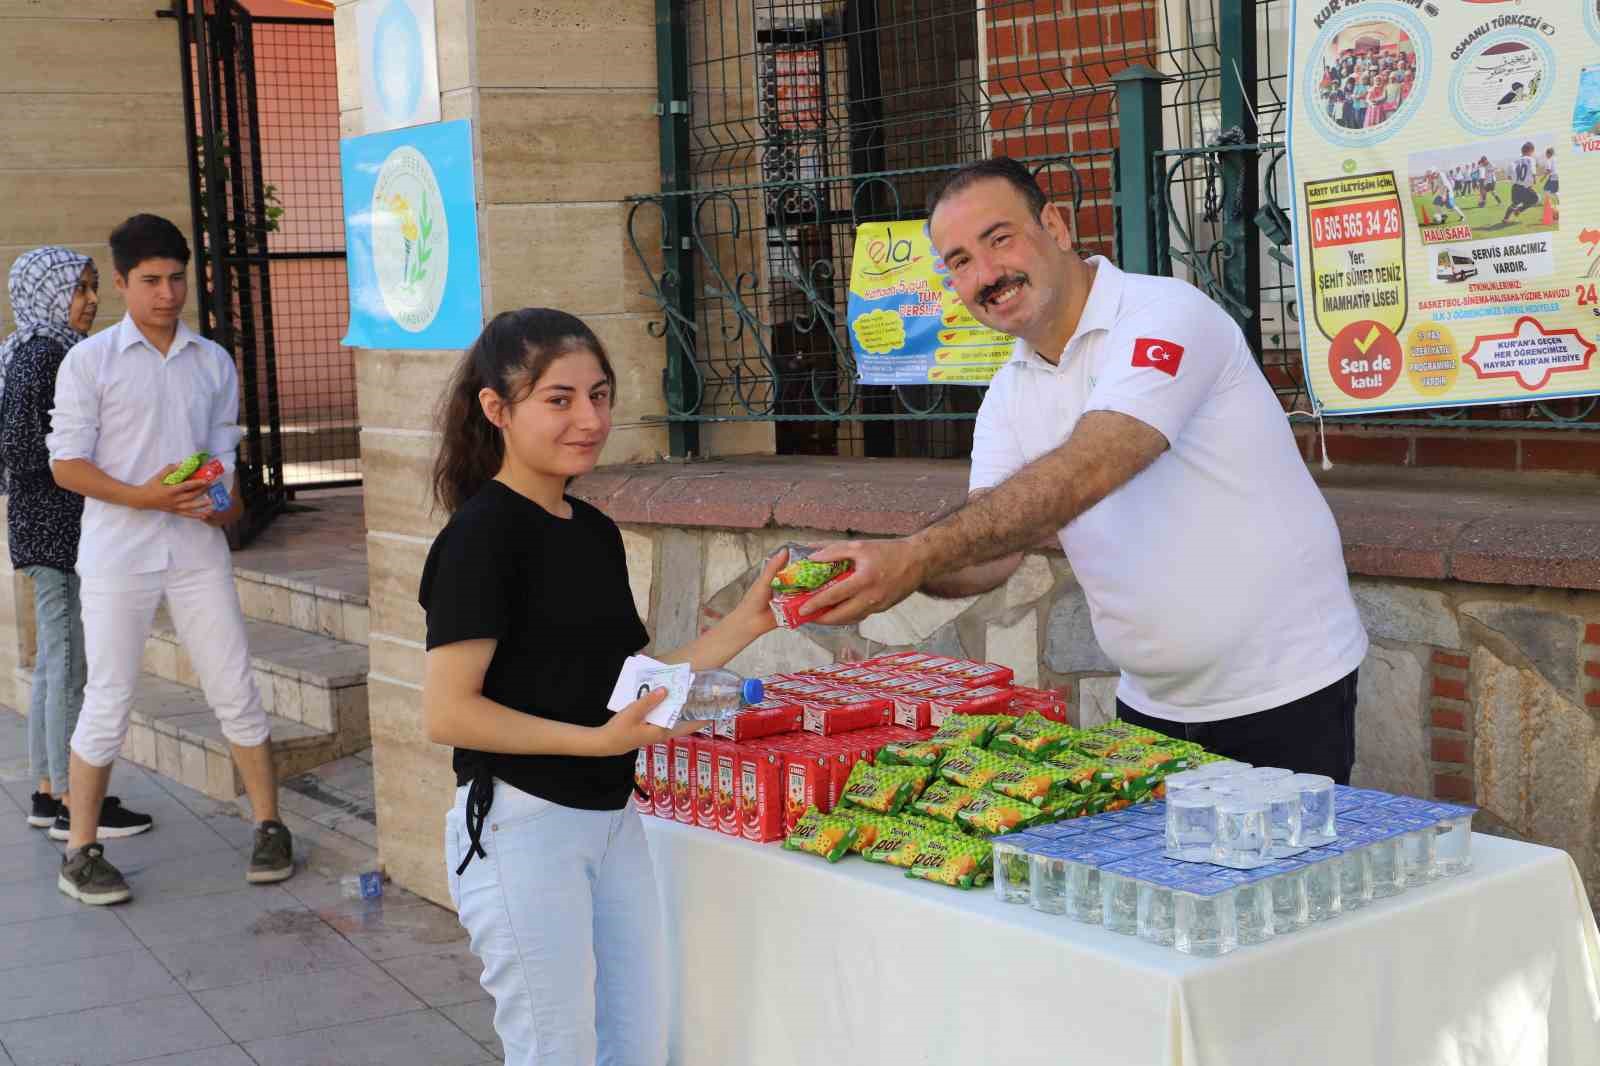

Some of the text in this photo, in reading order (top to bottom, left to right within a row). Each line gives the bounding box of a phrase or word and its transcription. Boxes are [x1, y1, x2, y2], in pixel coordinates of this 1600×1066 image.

[1450, 13, 1542, 60] OSMANLI TÜRKÇESİ
[1309, 187, 1328, 197] KAYIT
[1329, 185, 1339, 194] VE
[1315, 207, 1399, 241] 0 505 565 34 26
[1446, 225, 1471, 239] SAHA
[867, 226, 913, 264] ela
[1471, 241, 1547, 260] SERVİS ARACIMIZ
[1348, 250, 1366, 265] Yer:
[1493, 260, 1528, 274] VARDIR.
[1318, 262, 1402, 291] ŞEHİT SÜMER DENİZ
[1322, 286, 1399, 312] İMAMHATİP LİSESİ
[1575, 283, 1598, 305] 24
[1497, 338, 1536, 349] KUR'AN'A
[1483, 354, 1580, 369] HAYRAT KUR'AN HEDİYE
[1494, 350, 1511, 359] HER
[1340, 355, 1391, 374] Sen de
[1351, 374, 1383, 389] katıl!
